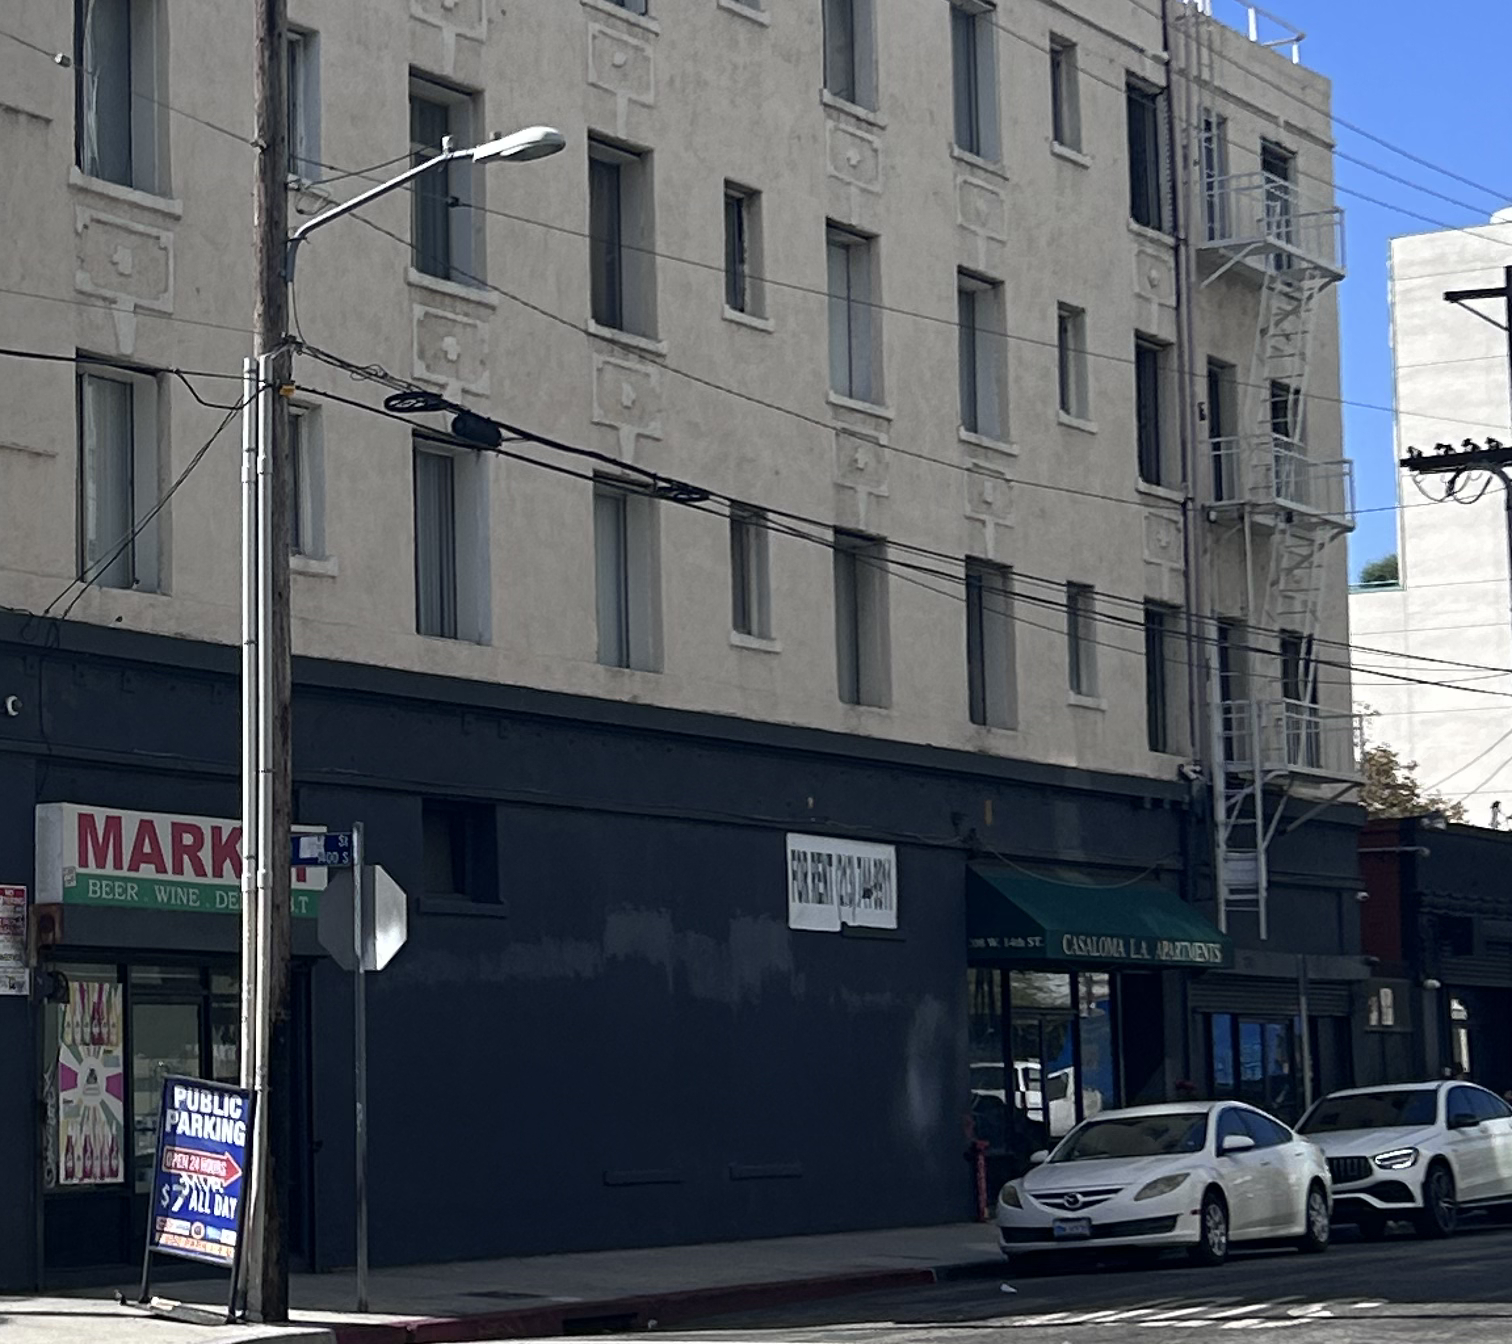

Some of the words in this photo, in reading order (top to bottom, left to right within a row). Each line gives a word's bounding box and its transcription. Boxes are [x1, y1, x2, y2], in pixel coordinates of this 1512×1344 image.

[77, 812, 308, 883] MARK
[88, 879, 139, 902] BEER
[154, 885, 201, 906] WINE
[215, 889, 240, 909] DE
[1062, 932, 1127, 958] CASALOMA
[1154, 939, 1224, 964] APARTMENTS
[174, 1085, 243, 1120] PUBLIC
[165, 1109, 247, 1147] PARKING
[214, 1192, 238, 1220] DAY
